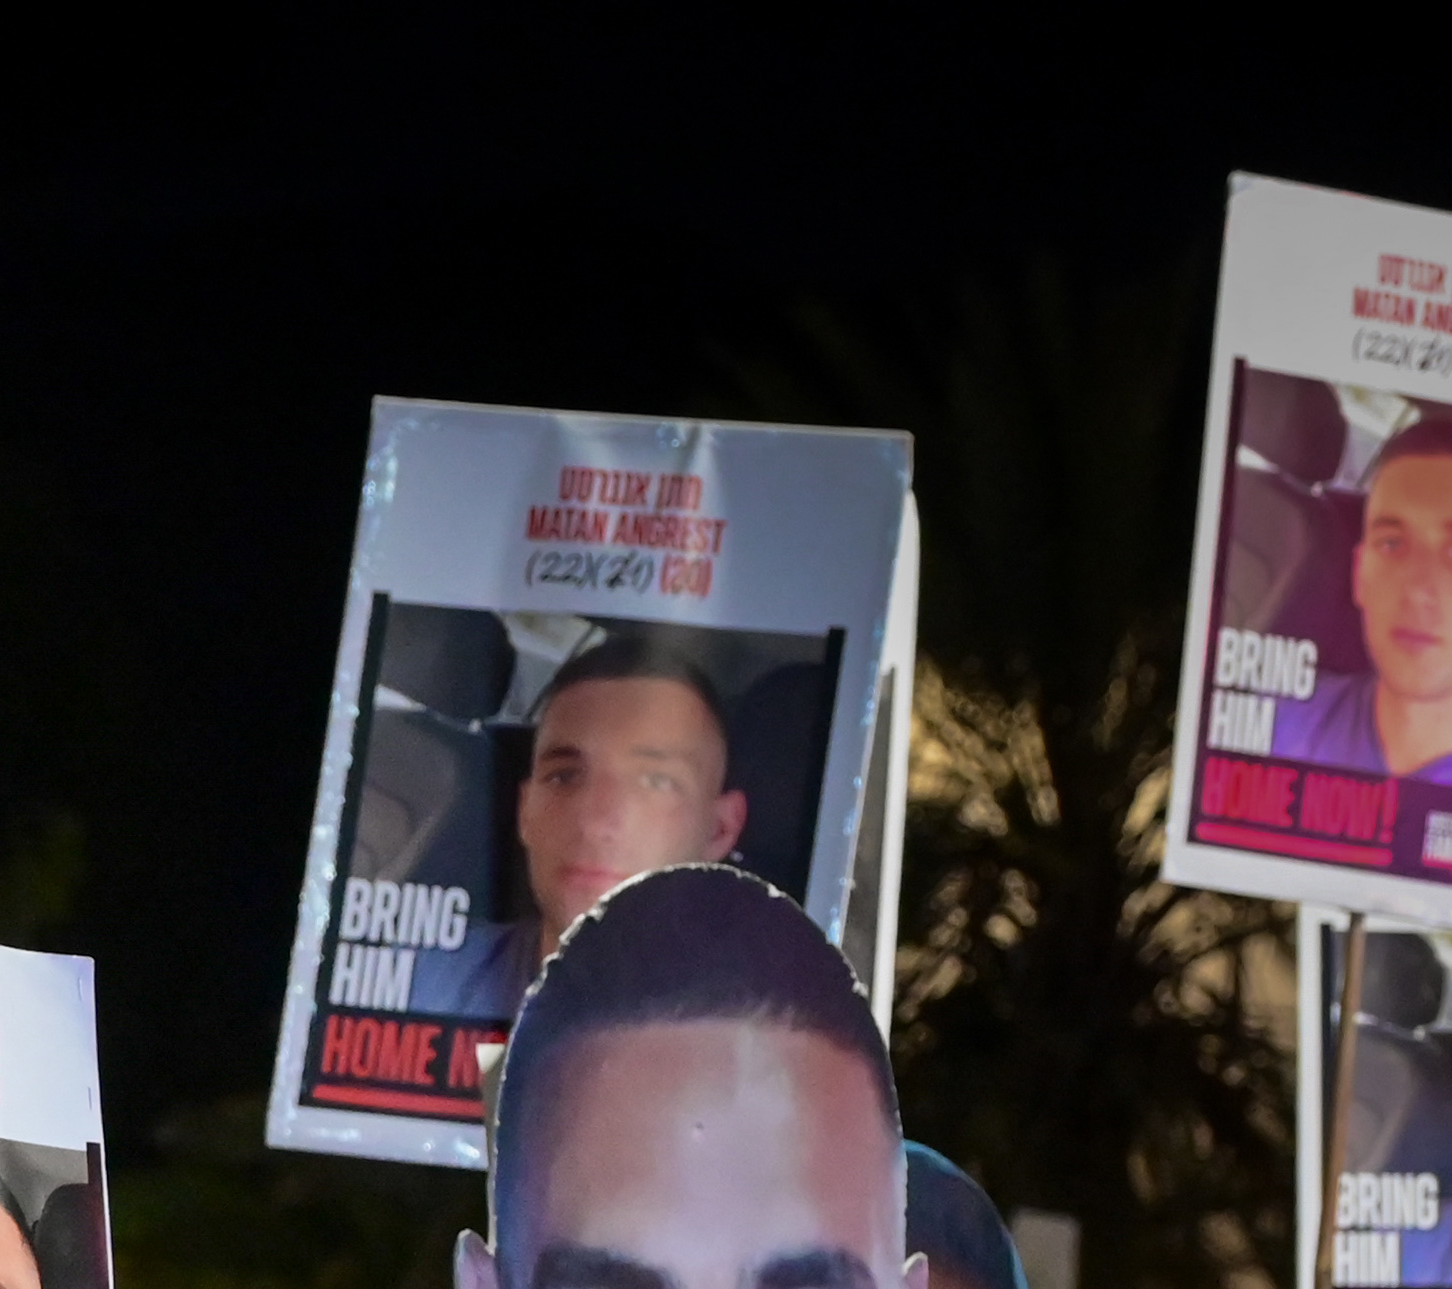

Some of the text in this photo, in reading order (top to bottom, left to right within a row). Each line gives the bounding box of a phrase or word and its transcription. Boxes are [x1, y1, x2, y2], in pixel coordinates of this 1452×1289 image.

[527, 505, 727, 554] MATAN ANGREST
[1215, 627, 1317, 700] BRING
[1208, 688, 1276, 756] HIM
[1202, 757, 1297, 827] HOME
[340, 877, 470, 950] BRING
[329, 942, 416, 1013] HIM
[322, 1014, 442, 1085] HOME
[1337, 1172, 1440, 1231] BRING
[1333, 1231, 1401, 1288] HIM
